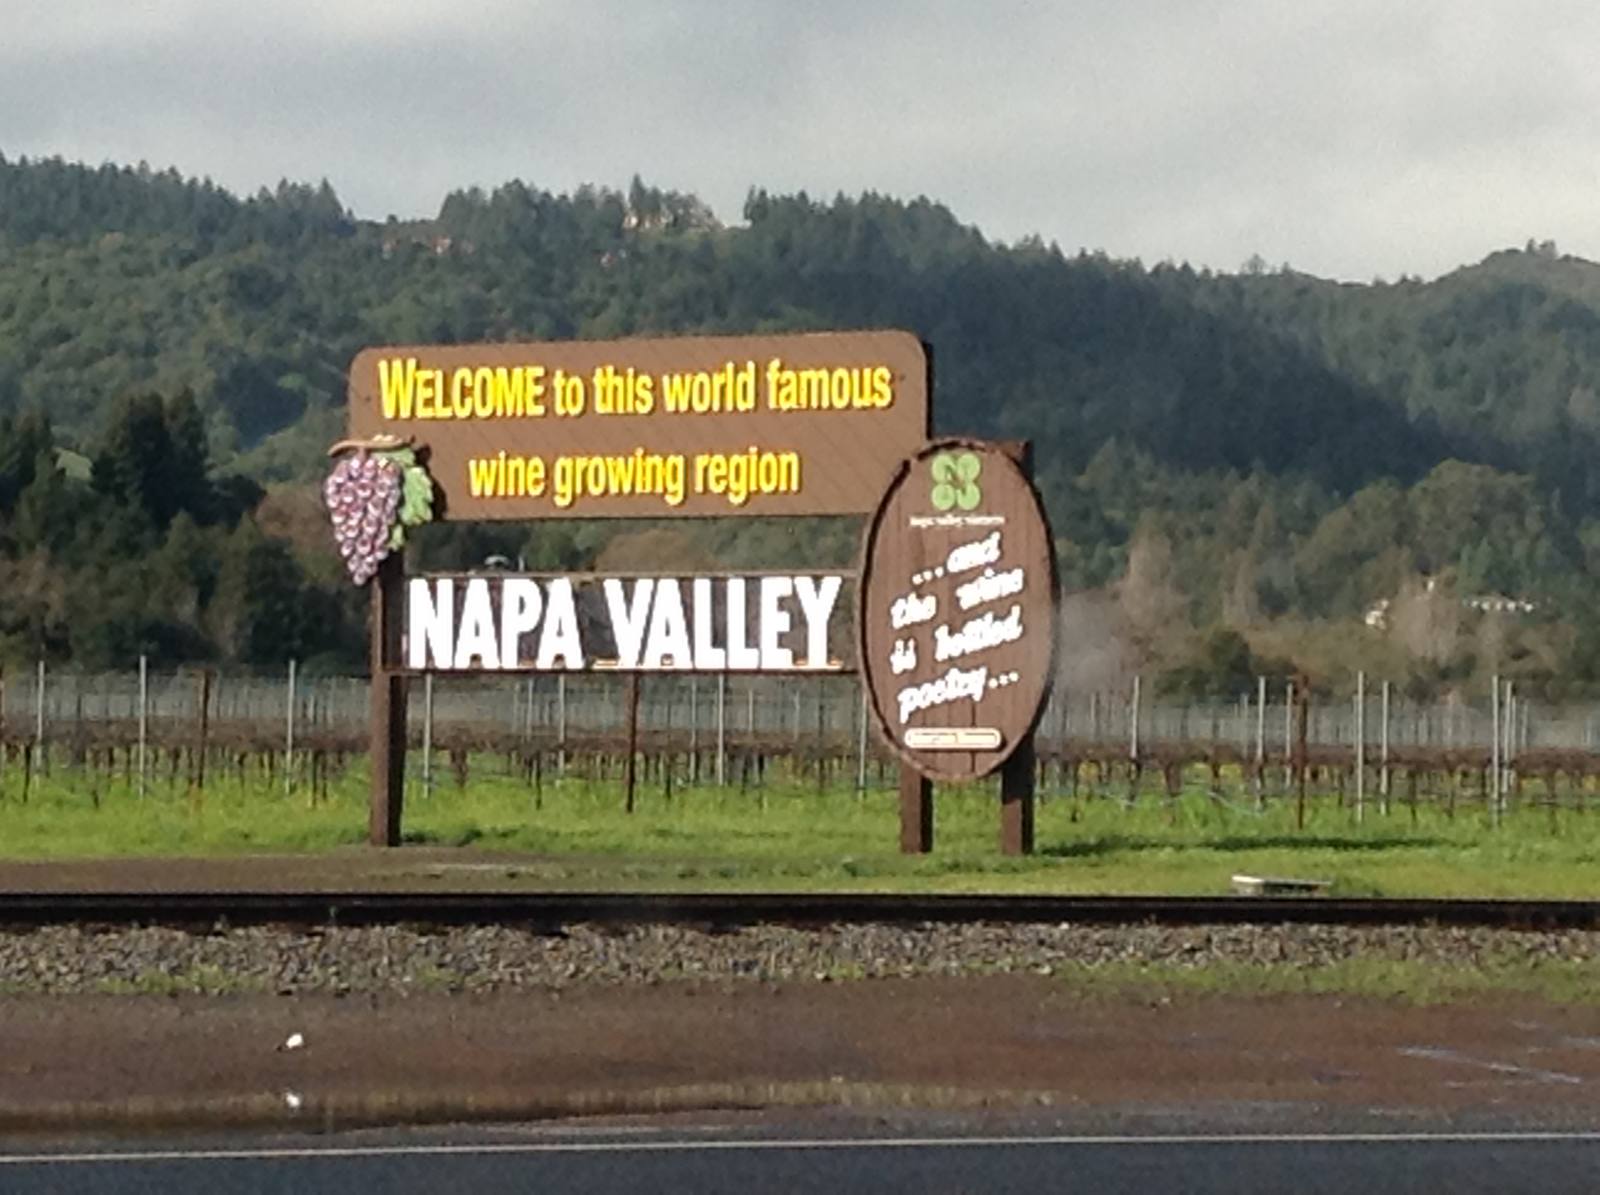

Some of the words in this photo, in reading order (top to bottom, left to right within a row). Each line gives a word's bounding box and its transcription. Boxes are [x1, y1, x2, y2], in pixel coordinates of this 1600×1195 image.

[379, 358, 545, 419] WELCOME
[554, 369, 586, 416] to
[594, 365, 654, 414] this
[662, 360, 756, 412] world
[767, 358, 893, 411] famous
[469, 450, 547, 497] wine
[554, 448, 686, 507] growing
[695, 446, 800, 506] region
[409, 577, 585, 669] NAPA
[598, 576, 843, 669] VALLEY
